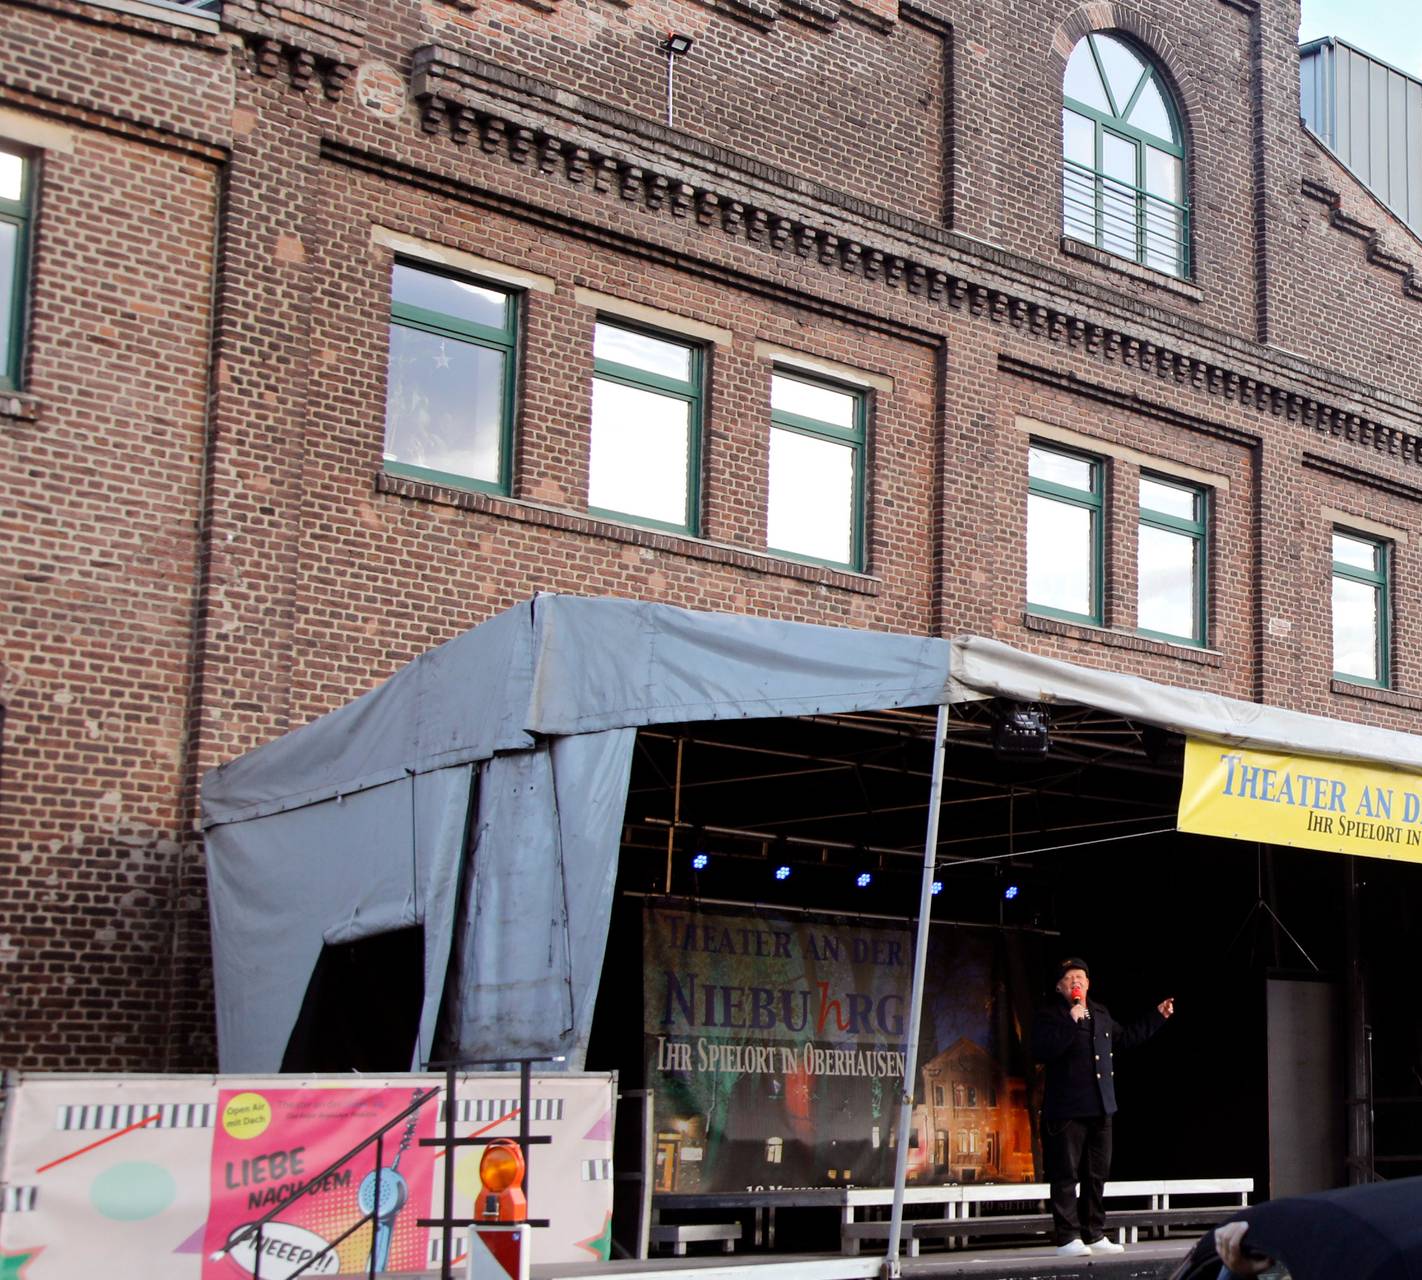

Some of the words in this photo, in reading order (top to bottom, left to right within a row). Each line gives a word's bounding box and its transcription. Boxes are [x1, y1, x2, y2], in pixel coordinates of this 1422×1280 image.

[1220, 754, 1347, 813] THEATER
[1356, 785, 1394, 819] AN
[1307, 811, 1333, 834] IHR
[1338, 816, 1403, 843] SPIELORT
[1406, 830, 1421, 846] IN
[665, 917, 792, 959] THEATER
[807, 933, 841, 961] AN
[853, 938, 905, 966] DER
[657, 1037, 692, 1071] IHR
[699, 1038, 776, 1074] SPIELORT
[781, 1048, 798, 1074] IN
[803, 1042, 905, 1077] OBERHAUSEN
[227, 1106, 250, 1116] Open
[227, 1119, 241, 1127] mit
[243, 1116, 266, 1125] Dach
[225, 1146, 305, 1189] LIEBE
